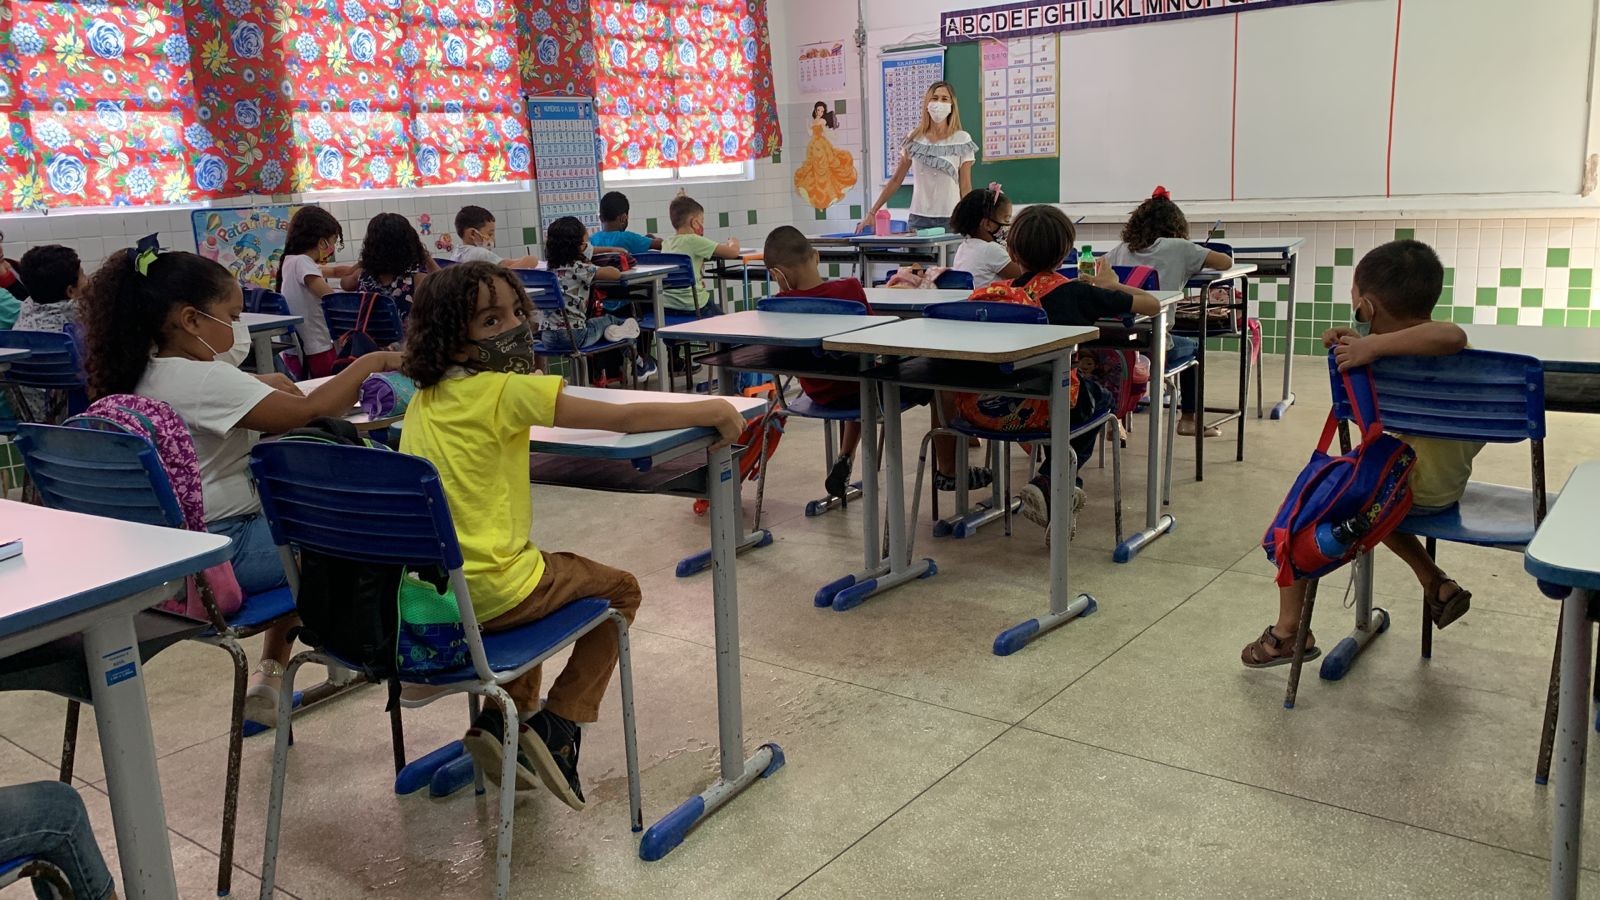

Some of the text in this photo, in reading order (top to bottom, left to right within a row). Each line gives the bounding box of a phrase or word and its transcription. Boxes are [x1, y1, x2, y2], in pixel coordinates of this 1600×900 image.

[947, 18, 959, 35] A
[963, 17, 974, 33] B
[979, 15, 991, 32] C
[996, 14, 1008, 30] D
[1011, 10, 1023, 28] E
[1028, 8, 1039, 26] F
[1044, 6, 1059, 24] G
[1062, 4, 1075, 22] H
[1093, 1, 1103, 18] J
[1111, 0, 1125, 17] K
[1129, 0, 1141, 16] L
